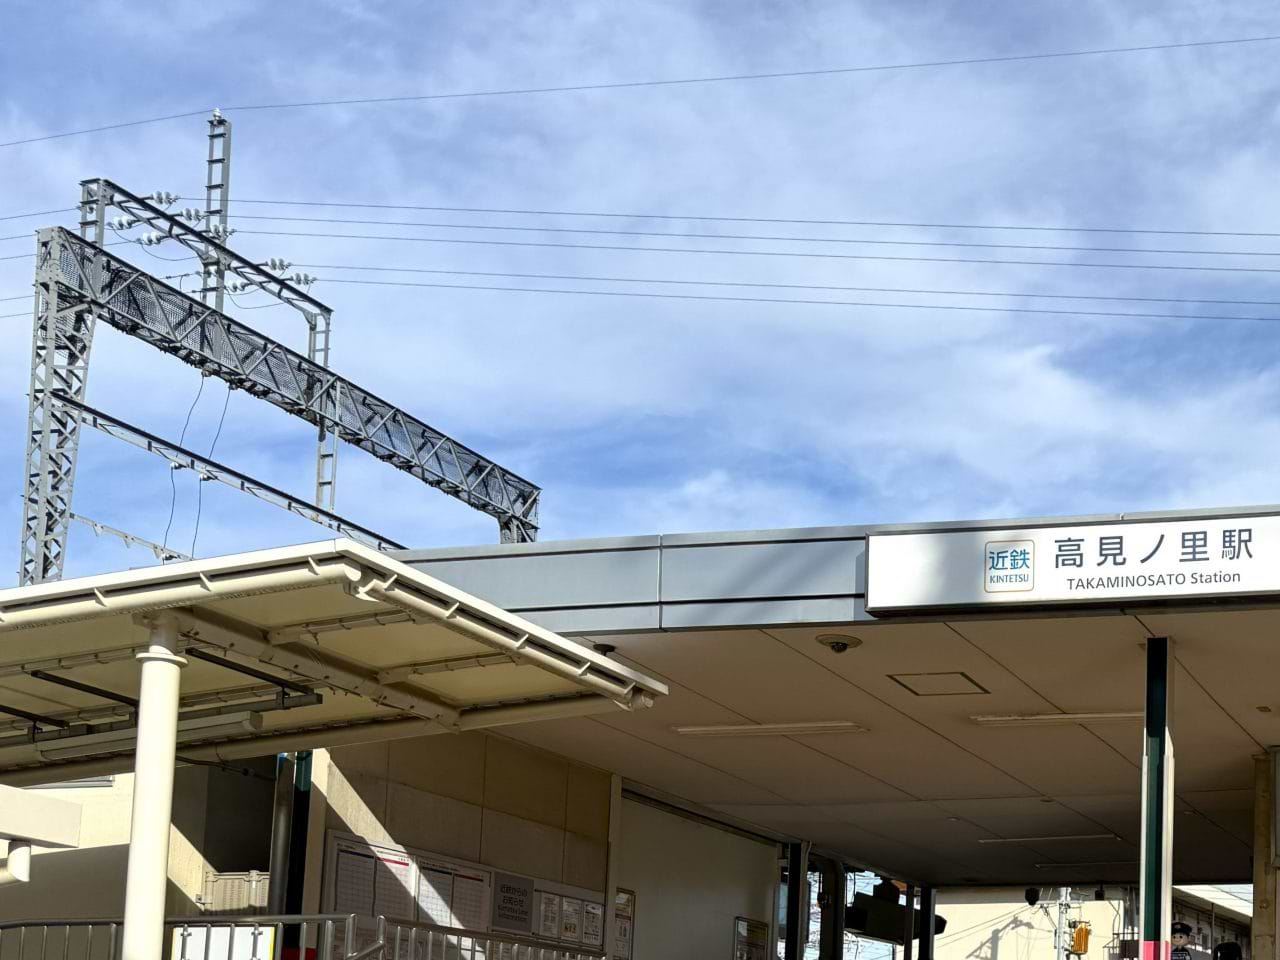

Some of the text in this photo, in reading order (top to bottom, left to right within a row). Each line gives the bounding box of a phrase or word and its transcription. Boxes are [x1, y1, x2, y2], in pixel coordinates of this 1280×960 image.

[1054, 528, 1254, 569] 高見ノ里駅
[988, 549, 1031, 571] 近鉄
[989, 573, 1029, 584] KINTETSU
[1066, 570, 1241, 590] TAKAMINOSATO Station
